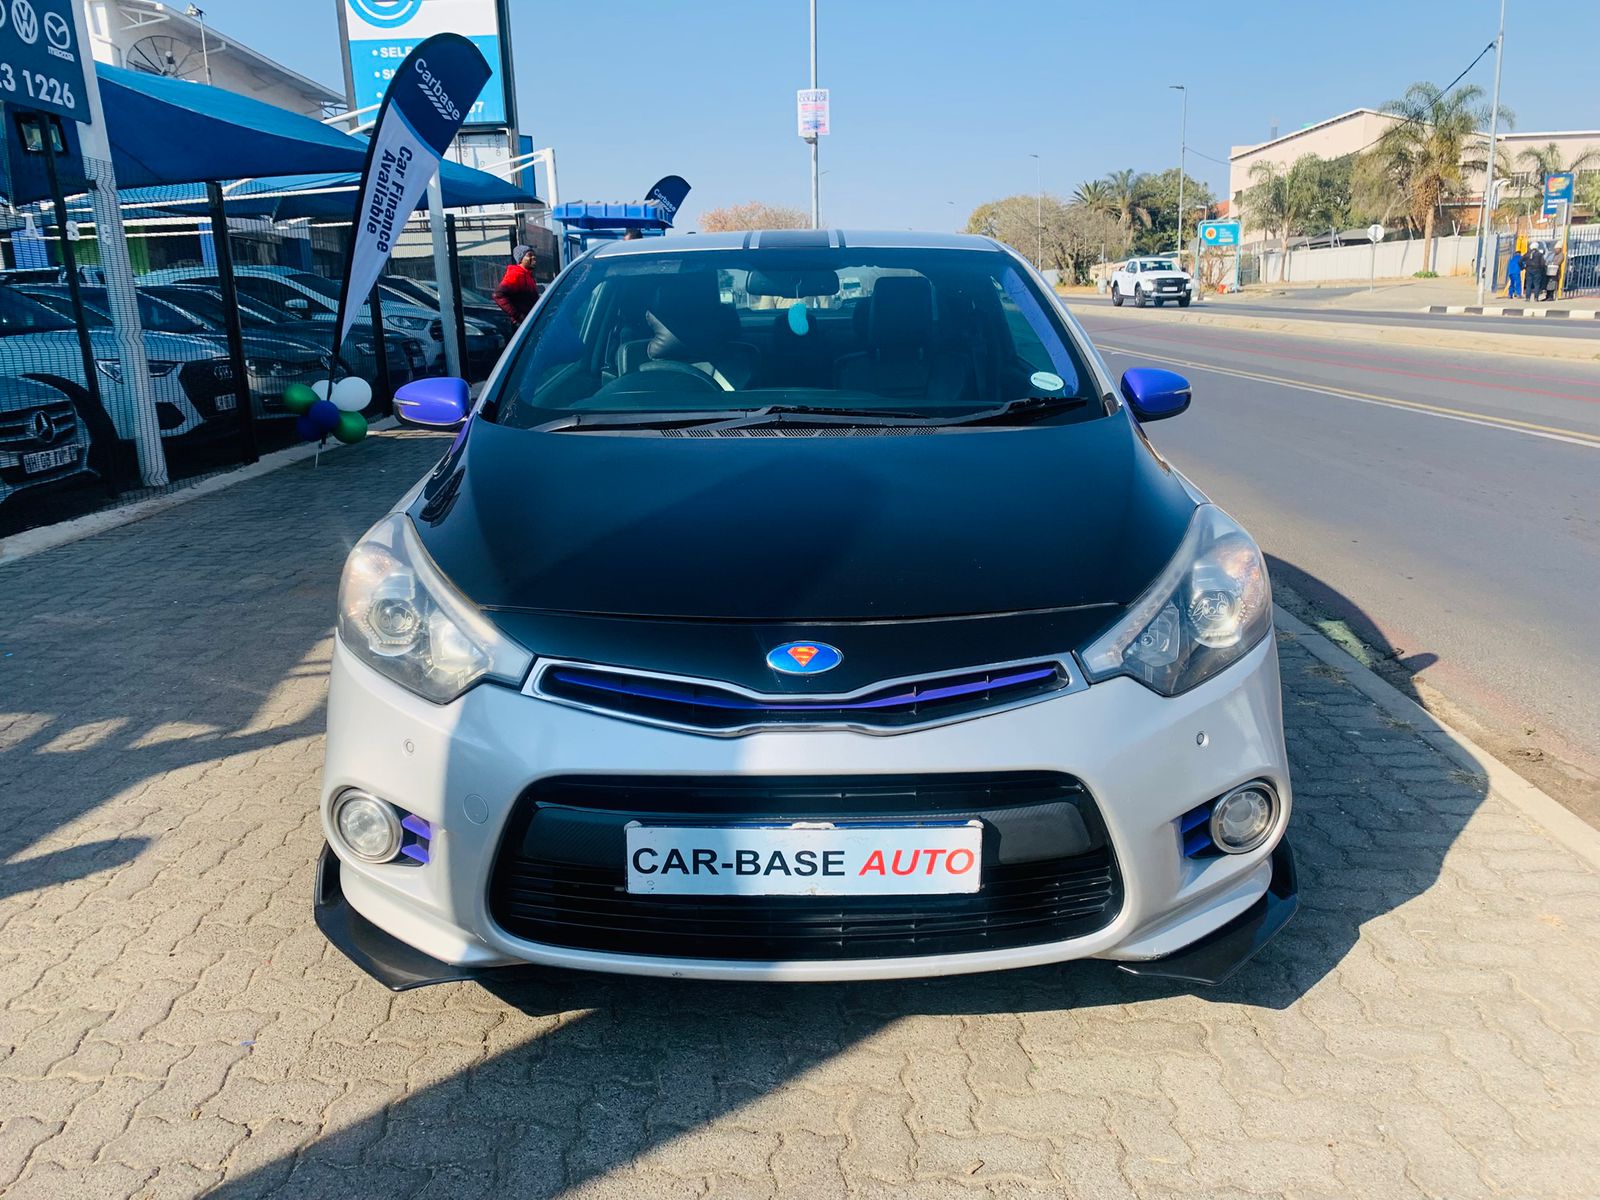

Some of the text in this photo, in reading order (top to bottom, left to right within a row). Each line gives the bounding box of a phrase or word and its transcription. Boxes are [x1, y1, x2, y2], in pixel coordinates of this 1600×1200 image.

[22, 69, 75, 109] 1226
[415, 58, 460, 121] Carbase
[367, 149, 397, 235] Available
[377, 145, 413, 253] Car Finance
[631, 847, 975, 877] CAR-BASE AUTO
